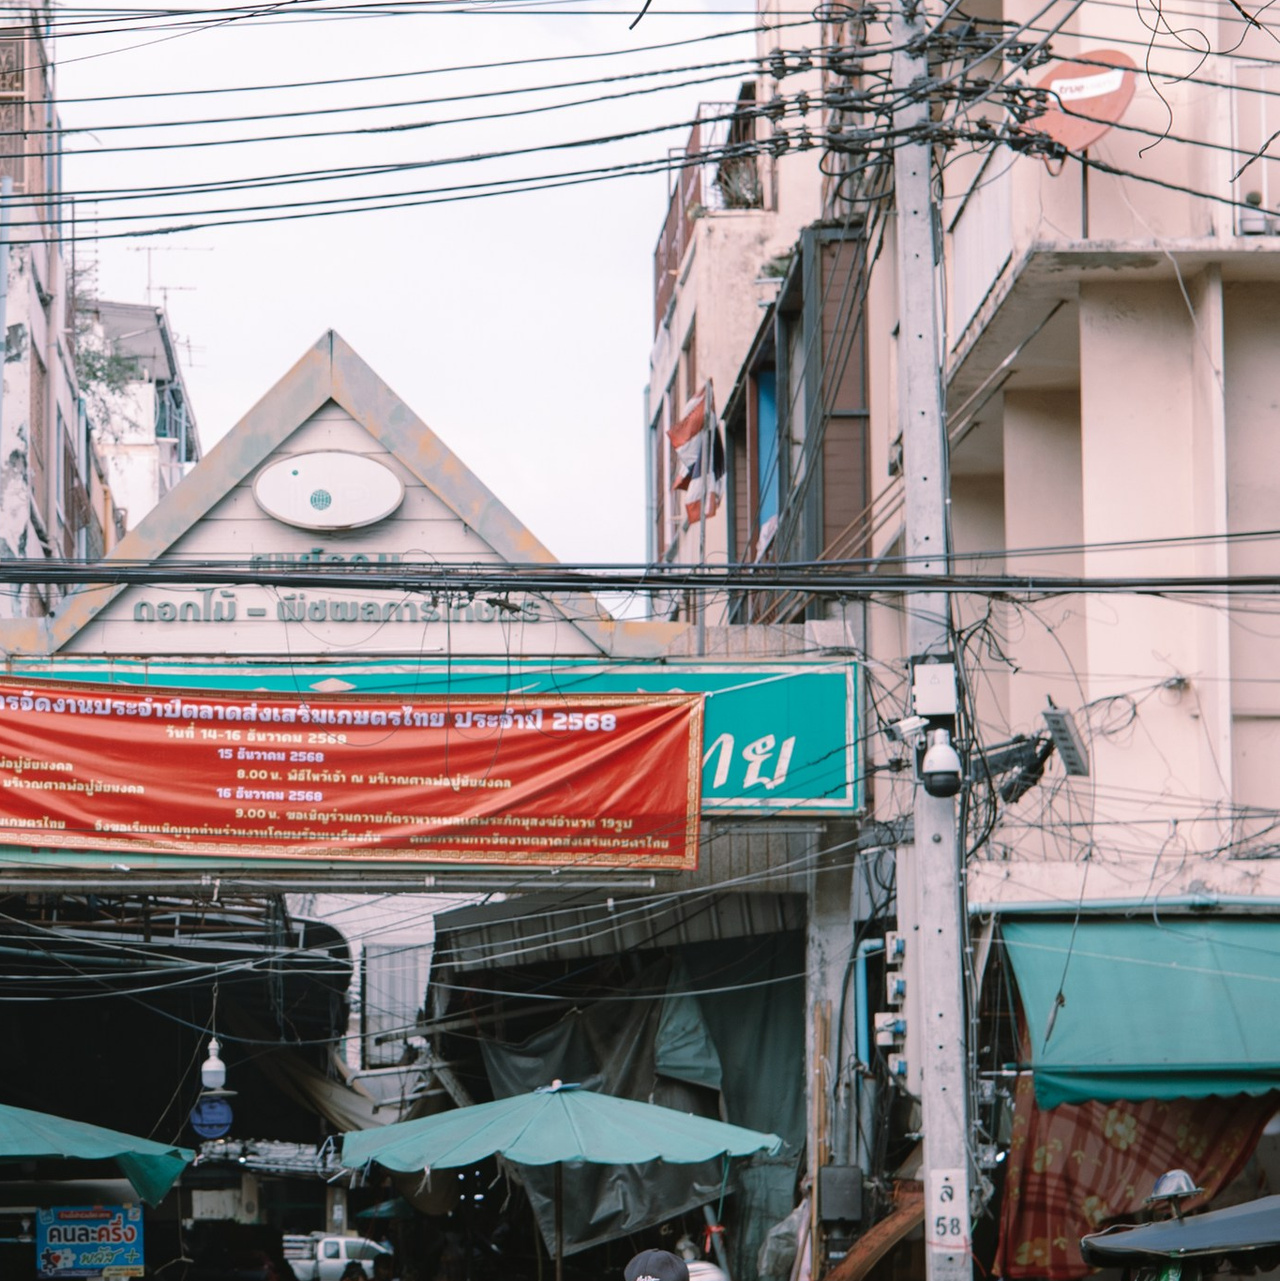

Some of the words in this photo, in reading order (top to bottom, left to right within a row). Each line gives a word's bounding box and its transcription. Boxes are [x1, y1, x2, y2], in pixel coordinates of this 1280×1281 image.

[1058, 84, 1085, 95] true
[133, 588, 237, 622] ดอกไม้
[454, 707, 543, 730] ประจำปี
[552, 711, 617, 732] 2568
[166, 721, 195, 739] วันที่
[200, 728, 241, 741] 14-16
[246, 728, 302, 743] ธันวาคม
[307, 732, 347, 745] 2568
[217, 748, 233, 760] 15
[237, 747, 285, 762] ธันวาคม
[289, 751, 325, 763] 2568
[236, 768, 268, 780] 8.00
[216, 787, 232, 799] 16
[235, 786, 284, 801] ธันวาคม
[288, 790, 323, 802] 2568
[235, 807, 267, 819] 9.00
[48, 1214, 137, 1244] คนละครึ่ง
[935, 1216, 961, 1237] 58
[79, 1246, 125, 1266] พลัส
